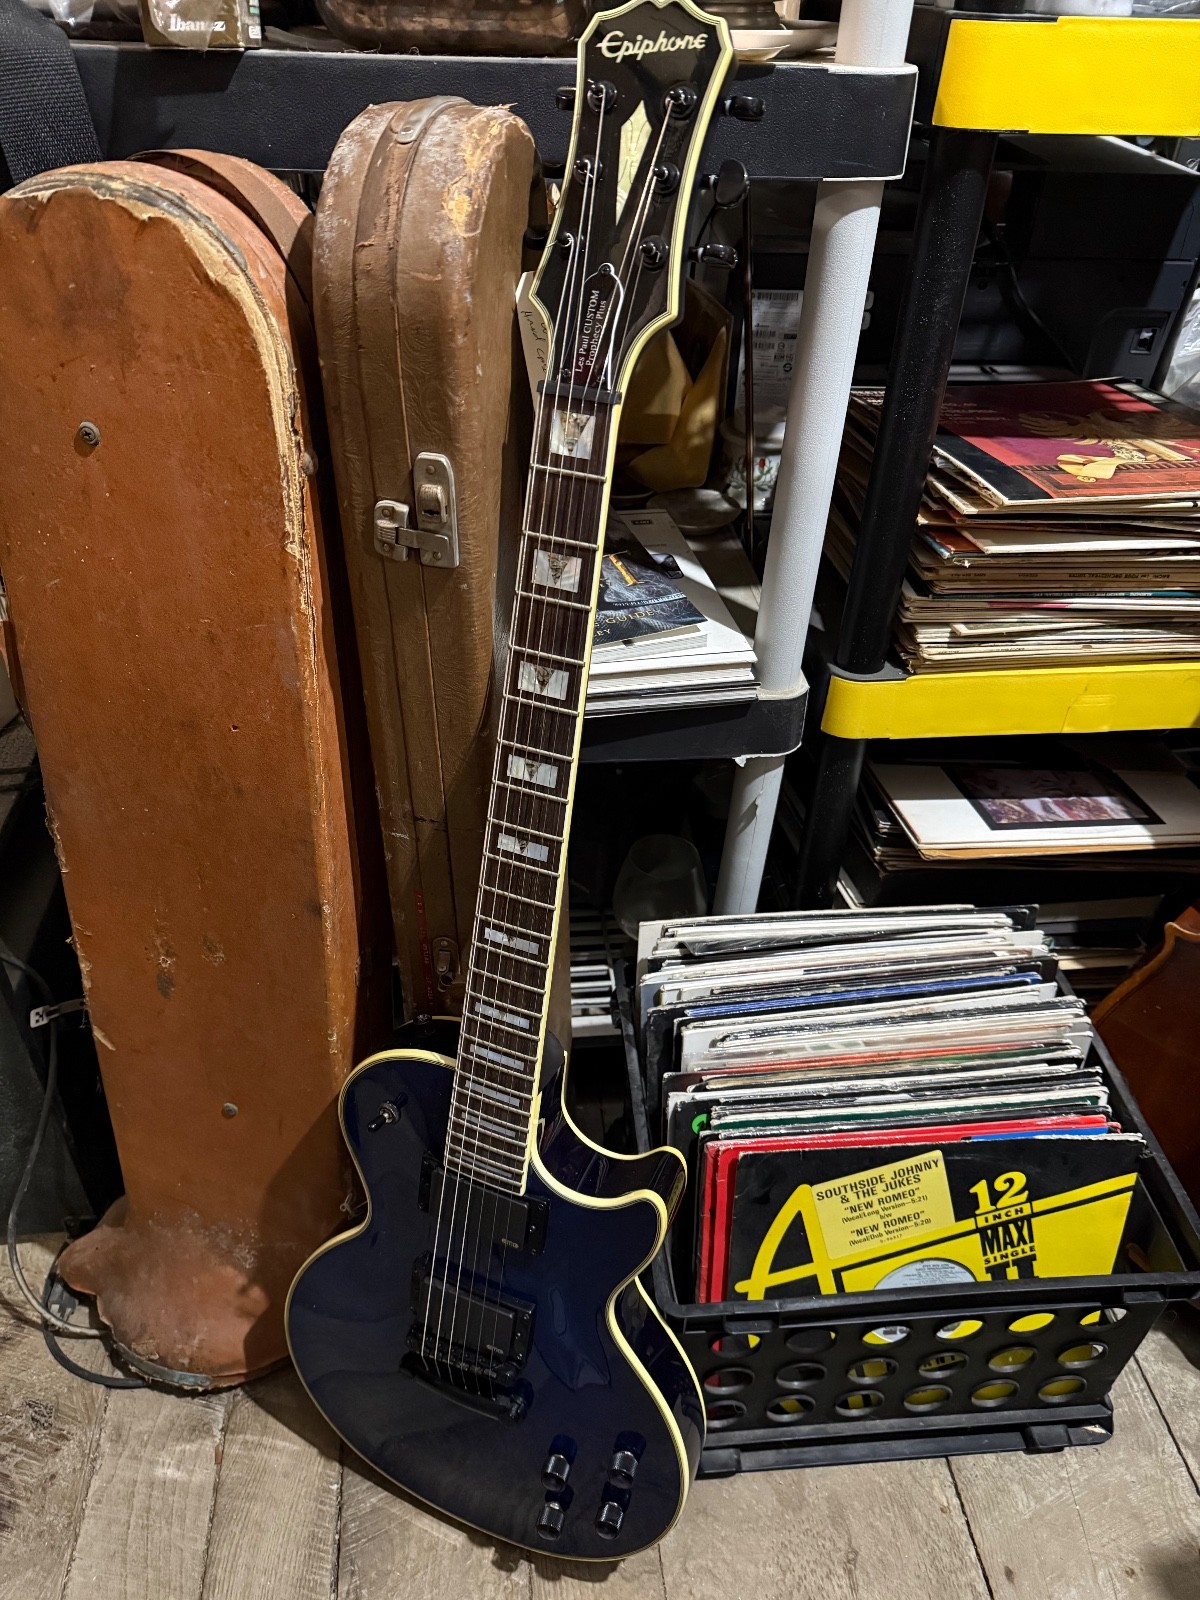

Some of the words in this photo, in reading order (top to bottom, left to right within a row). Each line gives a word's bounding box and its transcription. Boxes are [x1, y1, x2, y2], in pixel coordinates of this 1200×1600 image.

[595, 30, 709, 63] Epiphone
[583, 289, 600, 334] CUSTOM
[578, 335, 590, 355] Paul
[585, 322, 603, 366] Prophecy
[595, 300, 607, 320] Plus
[575, 356, 585, 372] Les
[605, 609, 655, 624] GUIDE
[816, 1174, 887, 1201] SOUTHSIDE
[890, 1159, 940, 1181] JOHNNY
[840, 1194, 850, 1204] &
[854, 1186, 878, 1200] THE
[882, 1174, 921, 1193] JUKES
[969, 1171, 1029, 1215] 12
[879, 1212, 893, 1220] b/w
[984, 1206, 1025, 1224] INCH
[979, 1218, 1035, 1257] MAXI
[984, 1245, 1037, 1266] SINGLE
